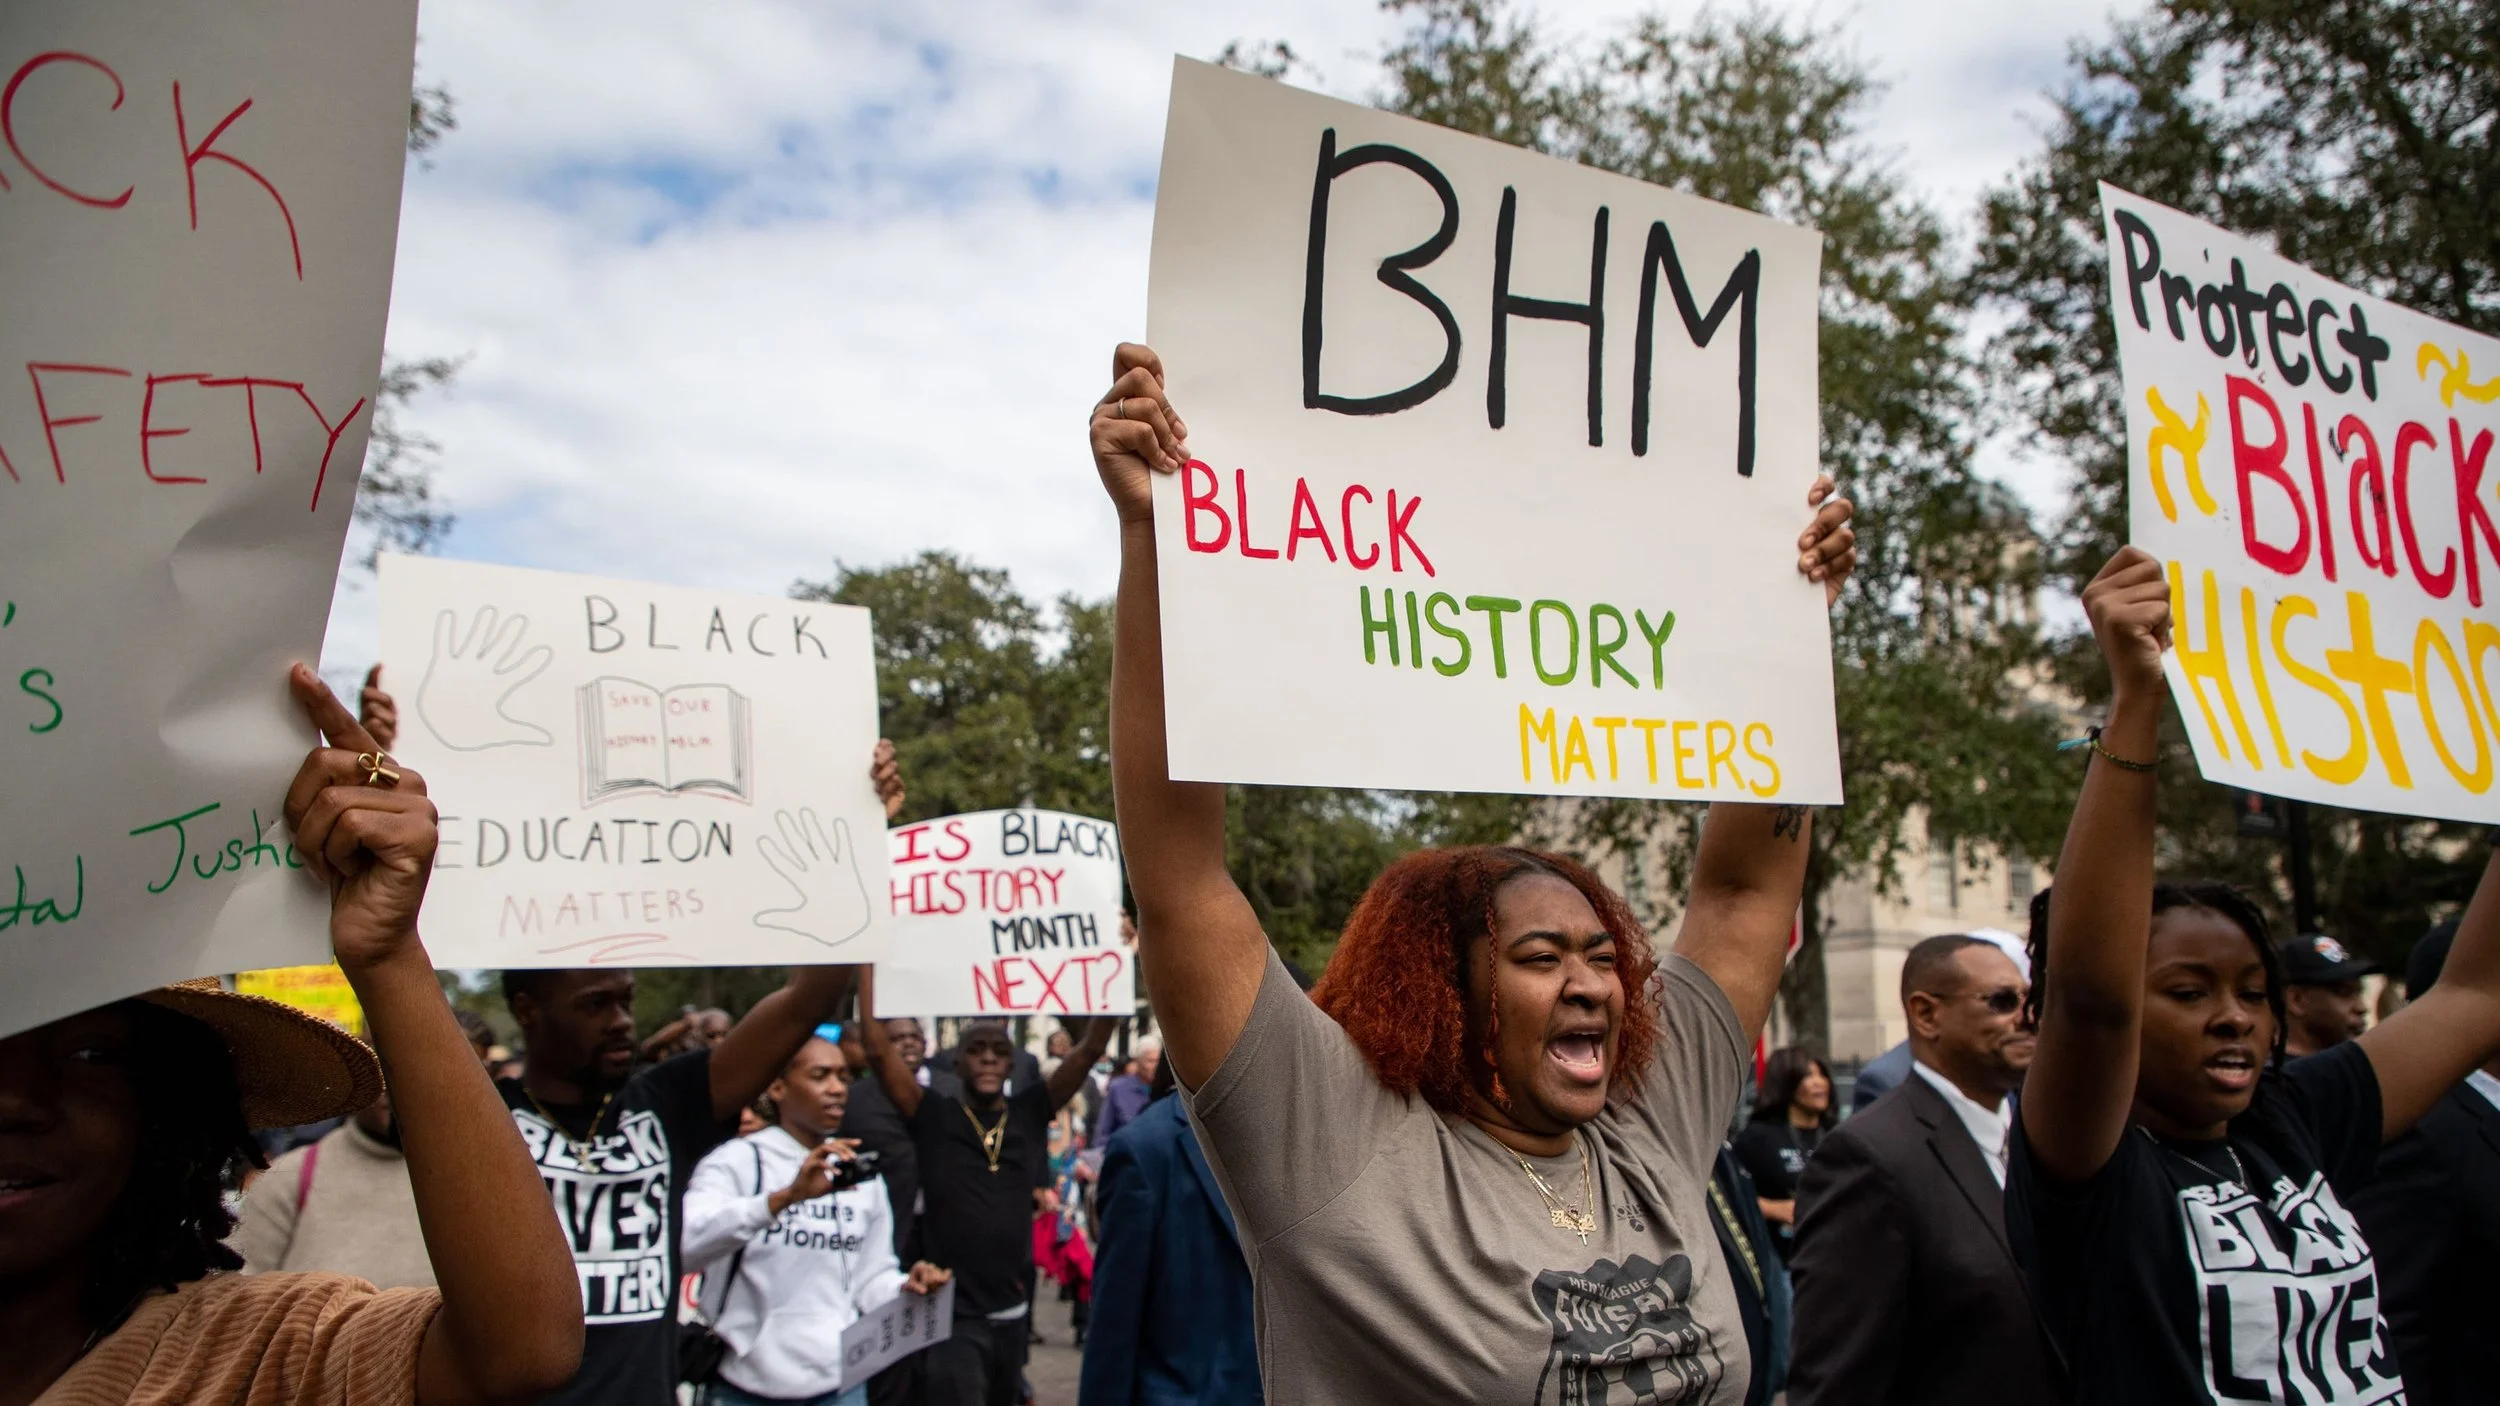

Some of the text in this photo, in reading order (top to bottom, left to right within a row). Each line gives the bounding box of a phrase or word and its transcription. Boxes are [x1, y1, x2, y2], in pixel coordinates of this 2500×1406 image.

[0, 50, 302, 281] CK
[1303, 127, 1760, 479] BHM
[2114, 208, 2390, 402] Protect
[0, 360, 366, 513] FETY
[1181, 458, 1436, 577] BLACK
[585, 594, 829, 660] BLACK
[1359, 585, 1676, 690] HISTORY
[666, 697, 711, 717] OUR
[1519, 702, 1781, 798] MATTERS
[894, 812, 1114, 865] IS BLACK
[0, 854, 83, 933] tal
[499, 888, 704, 939] MATTERS
[890, 866, 1065, 917] HISTORY
[990, 912, 1099, 955] MONTH
[972, 950, 1123, 1015] NEXT?
